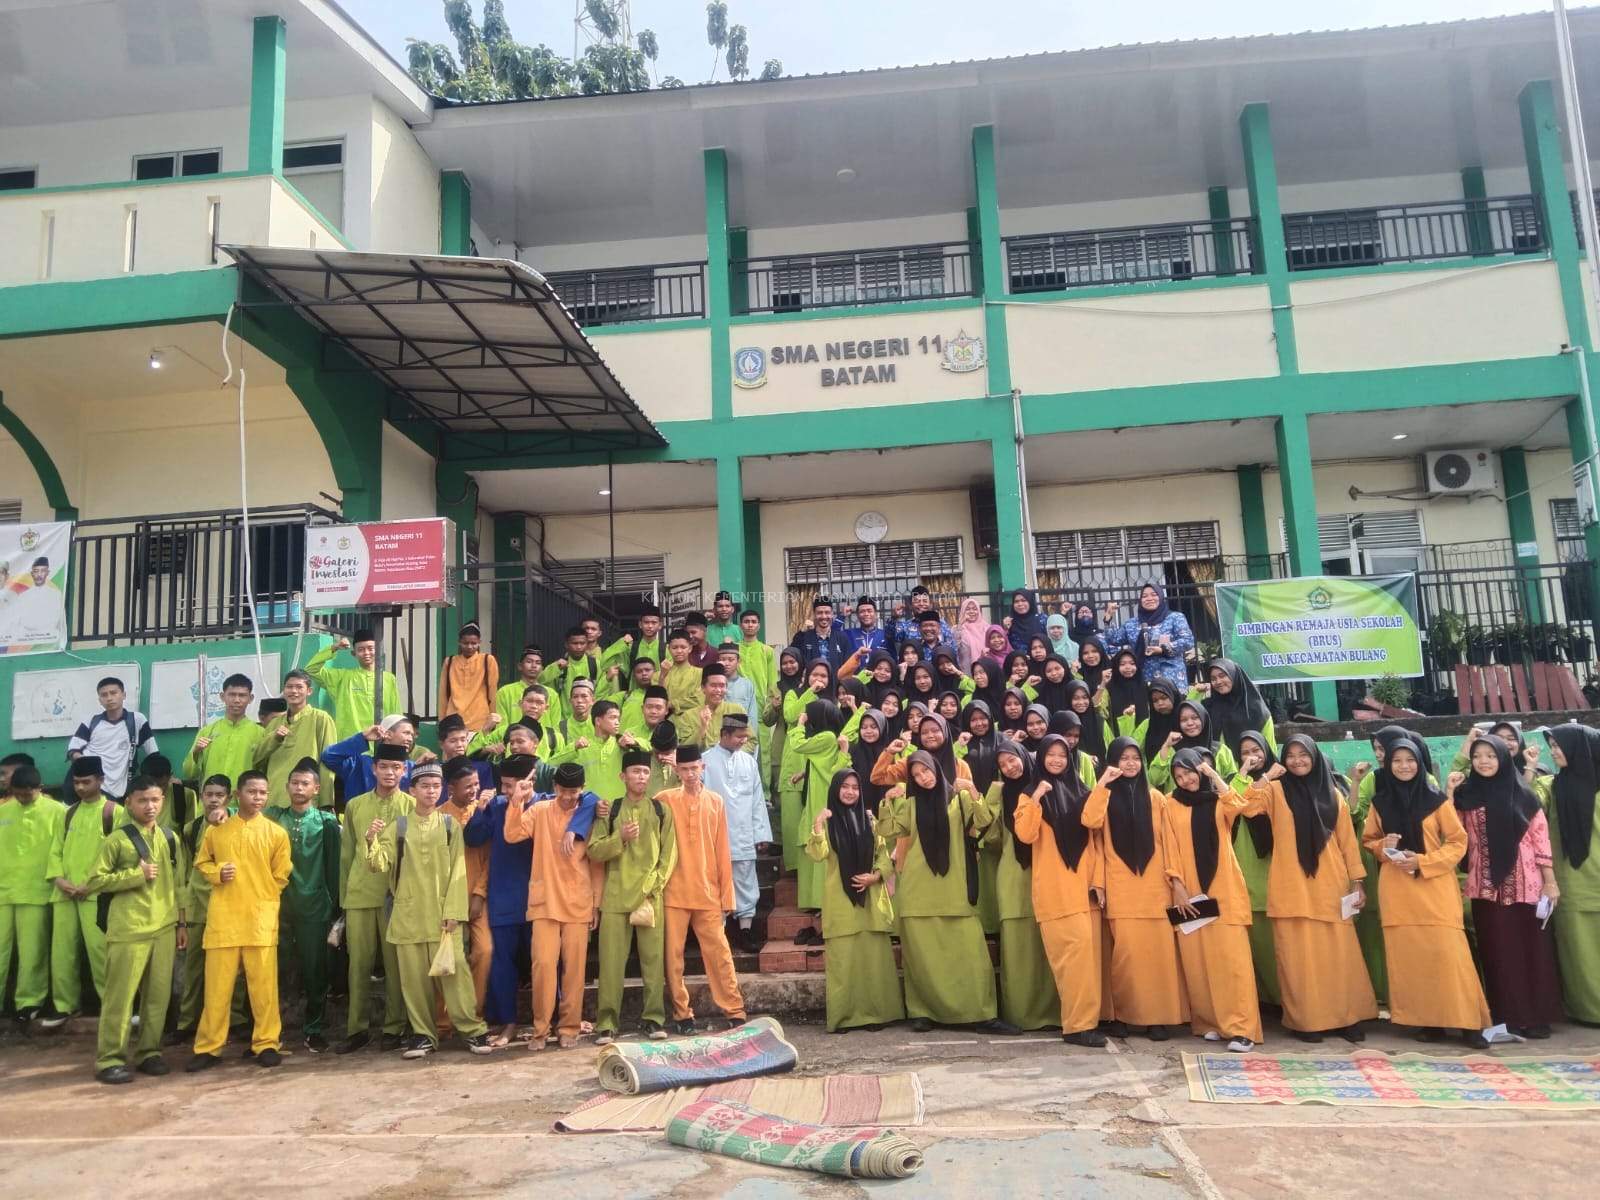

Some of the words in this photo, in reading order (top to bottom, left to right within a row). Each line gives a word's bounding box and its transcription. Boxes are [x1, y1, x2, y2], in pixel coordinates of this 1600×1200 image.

[771, 344, 819, 364] SMA
[826, 338, 909, 361] NEGERI
[918, 335, 942, 354] 11
[821, 364, 896, 387] BATAM
[391, 533, 414, 541] NEGERI
[323, 556, 359, 568] Galeri
[311, 568, 358, 579] Investasi
[1237, 621, 1293, 635] BIMBINGAN
[1296, 619, 1336, 632] REMAJA
[1338, 618, 1359, 629] USIA
[1361, 616, 1403, 629] SEKOLAH
[1308, 635, 1341, 648] (BRUS)
[1262, 654, 1285, 667] KUA
[1287, 652, 1350, 665] KECAMATAN
[1350, 649, 1386, 663] BULANG
